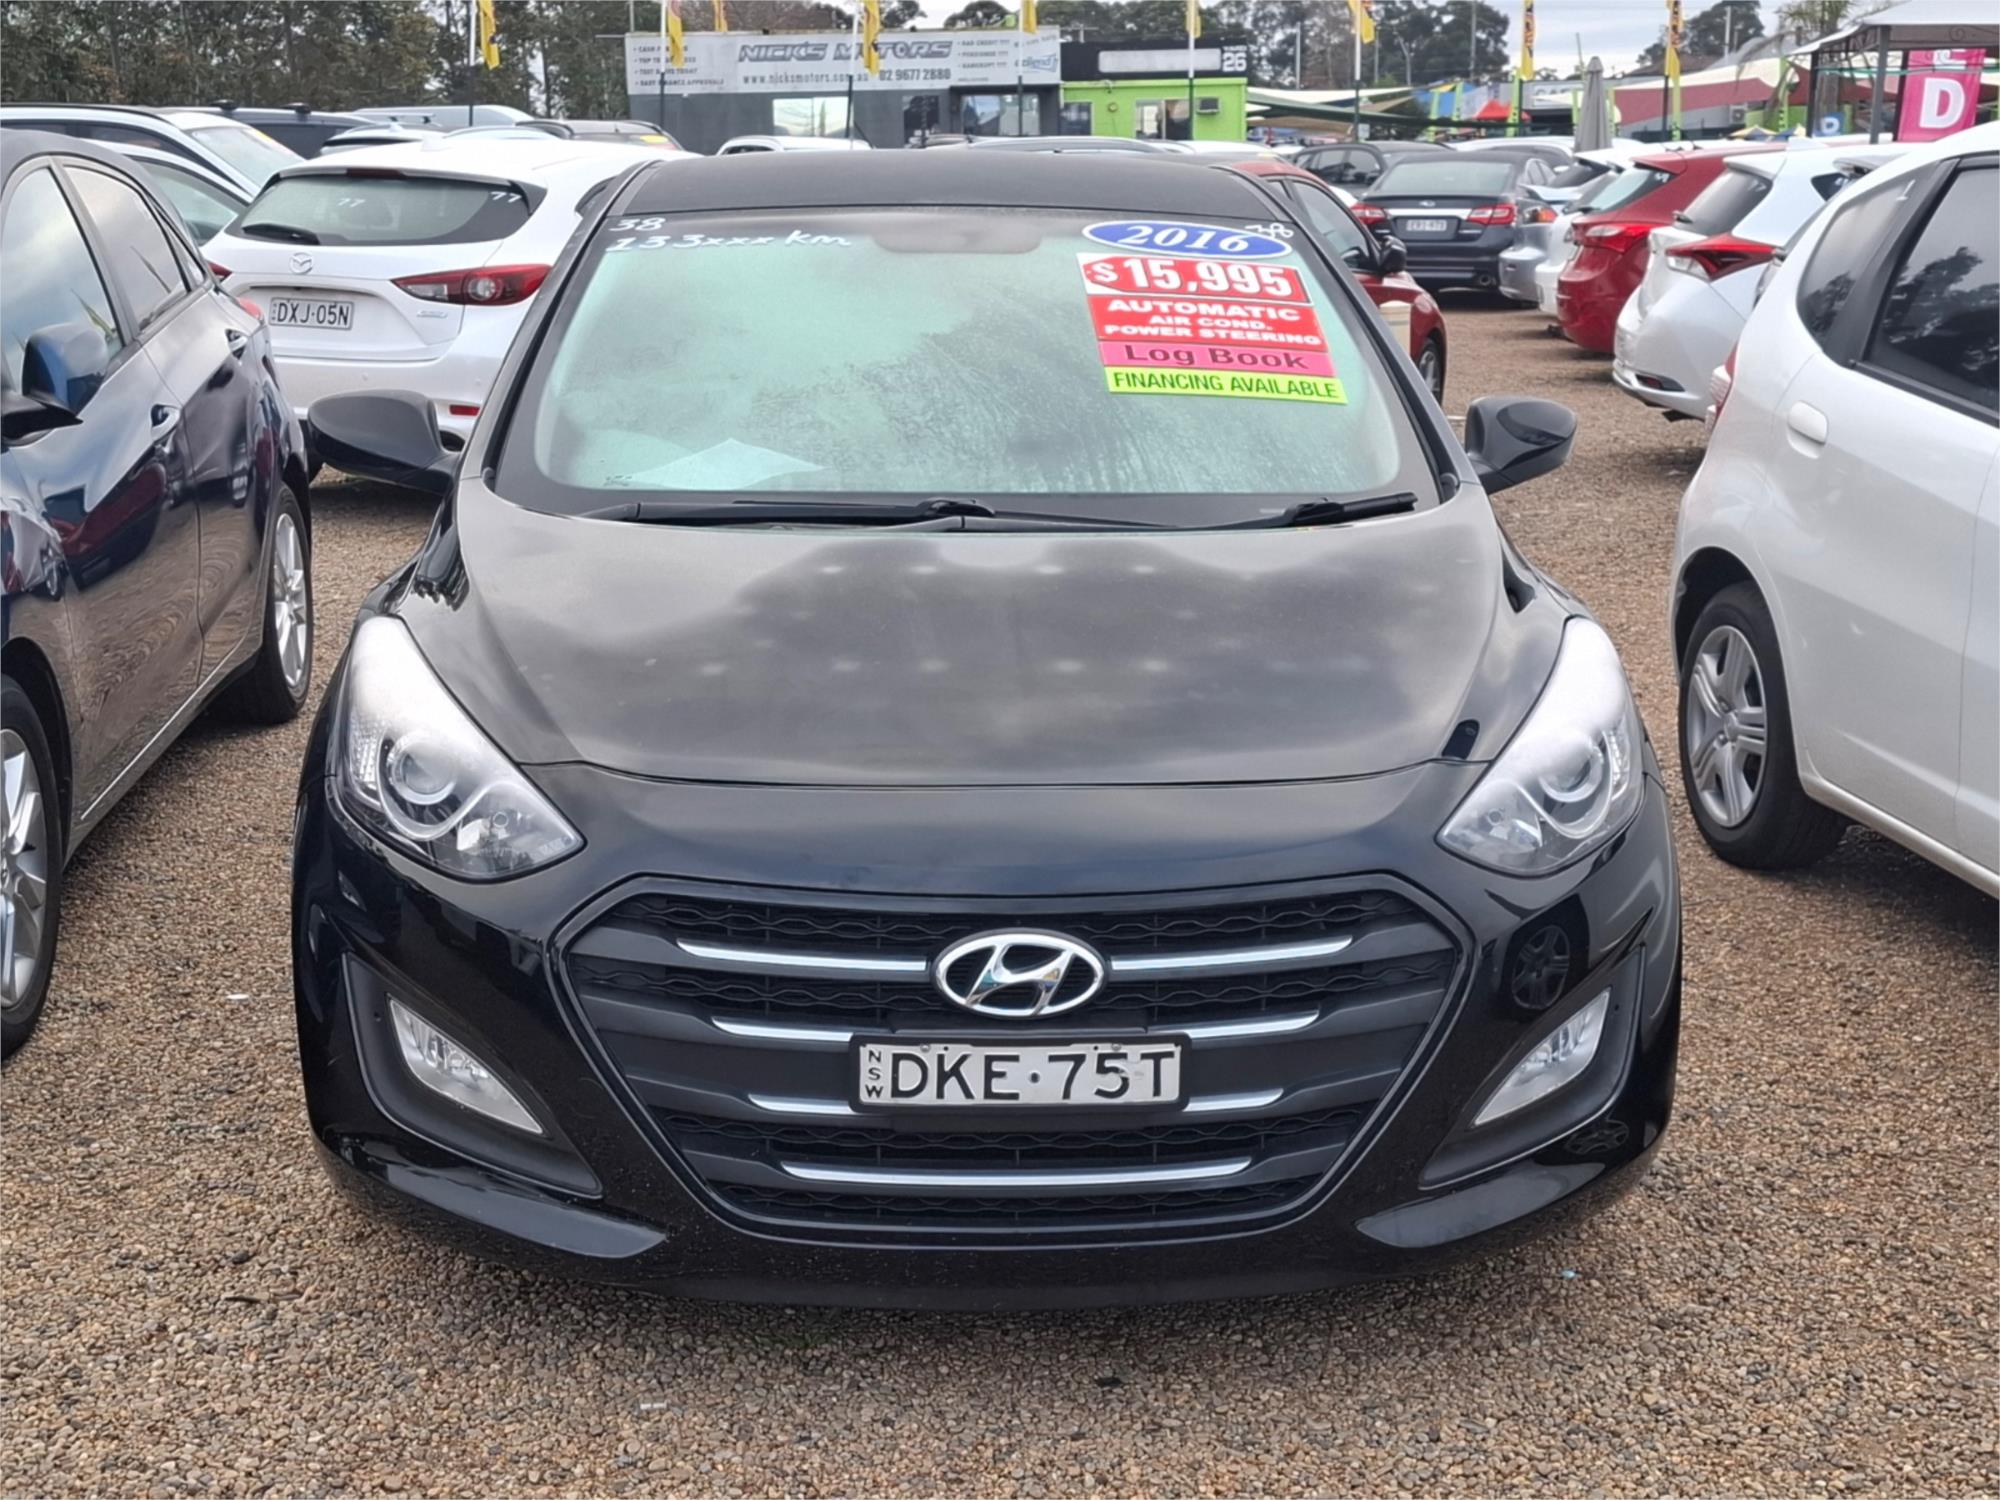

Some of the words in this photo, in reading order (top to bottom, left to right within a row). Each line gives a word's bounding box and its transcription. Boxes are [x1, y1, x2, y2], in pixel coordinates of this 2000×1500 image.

[834, 40, 953, 61] MTORS
[1222, 52, 1247, 72] 26
[491, 190, 522, 203] 77
[609, 217, 666, 231] 38
[784, 230, 852, 247] km
[1117, 224, 1249, 252] 2016
[1108, 298, 1301, 322] AUTOMATIC
[1149, 314, 1194, 326] AIR
[1197, 316, 1273, 331] COND.
[1104, 324, 1194, 338] POWER
[1201, 327, 1322, 346] STEERING
[1125, 344, 1195, 366] Log
[1211, 347, 1308, 370] Book
[1113, 371, 1225, 392] FINANCING
[1230, 377, 1339, 399] AVAILABLE
